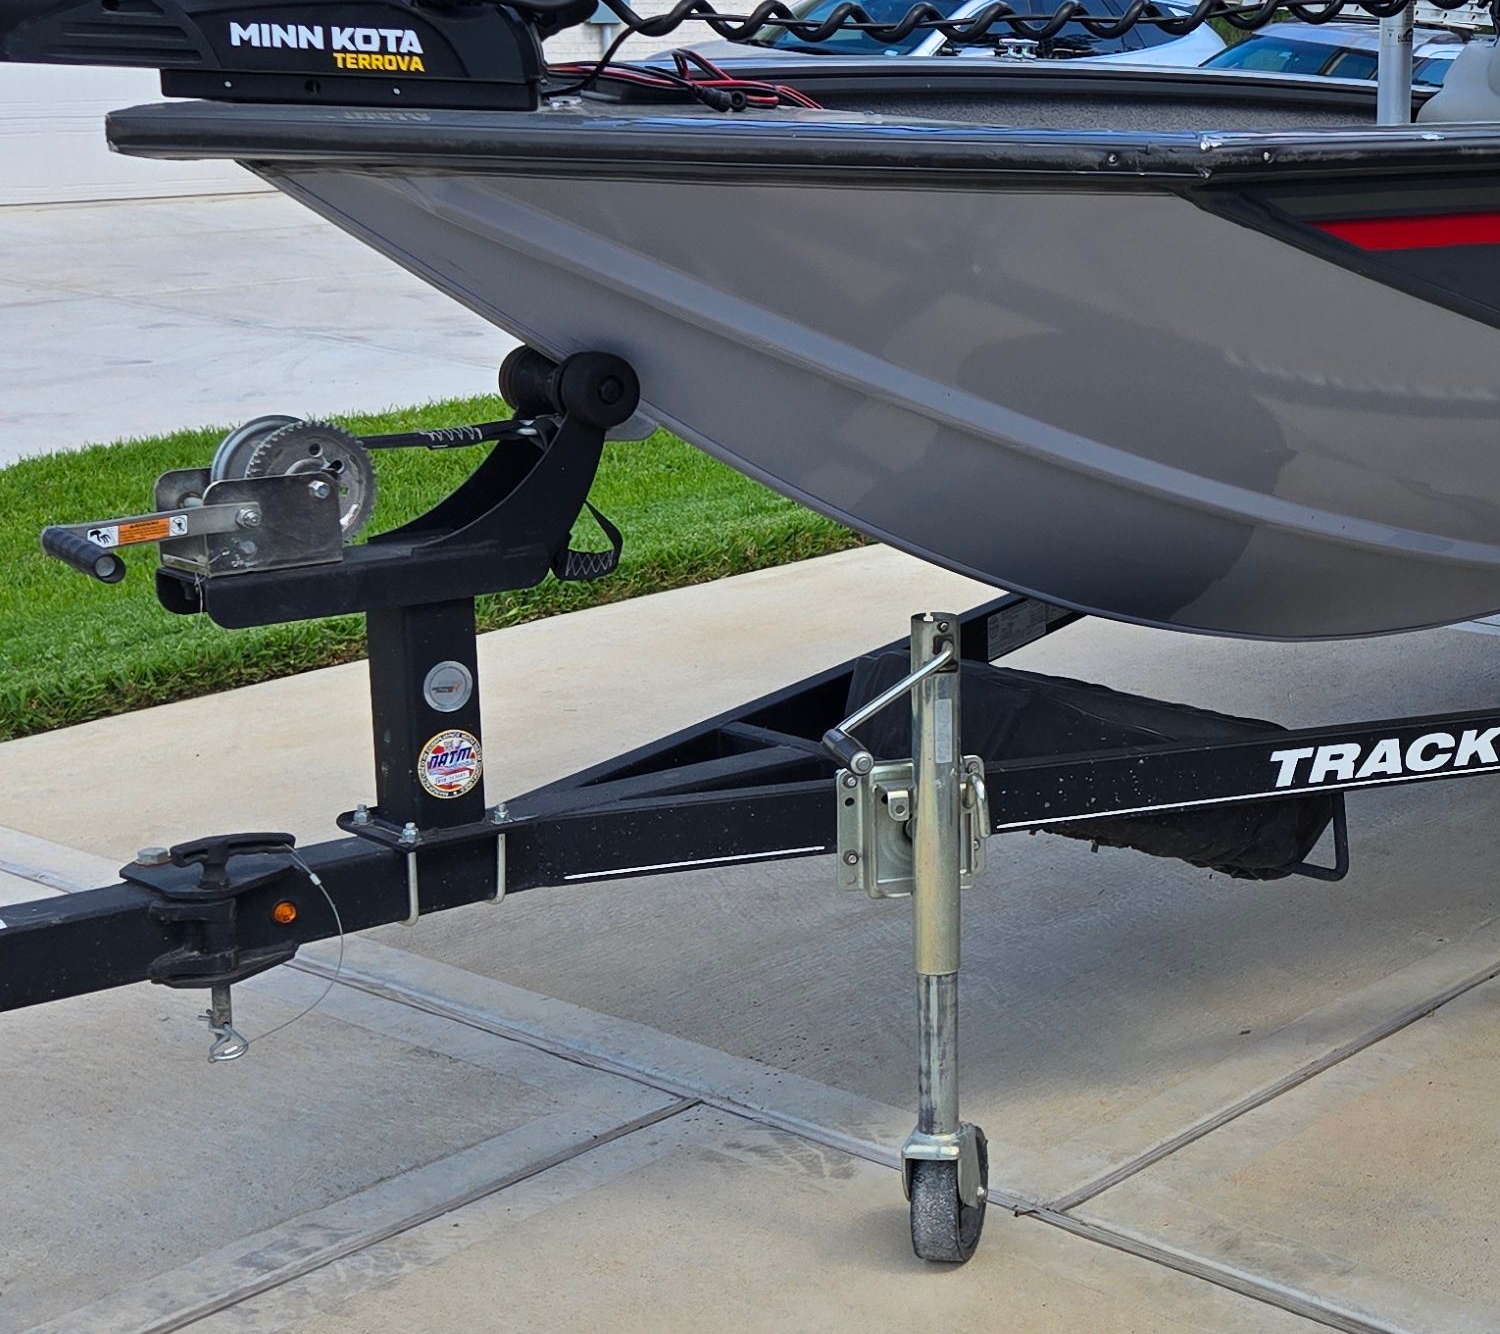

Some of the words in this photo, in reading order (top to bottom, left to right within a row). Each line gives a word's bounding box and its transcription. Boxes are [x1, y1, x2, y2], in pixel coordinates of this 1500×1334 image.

[229, 22, 324, 49] MINN
[331, 26, 424, 54] KOTA
[332, 52, 425, 72] TERROVA
